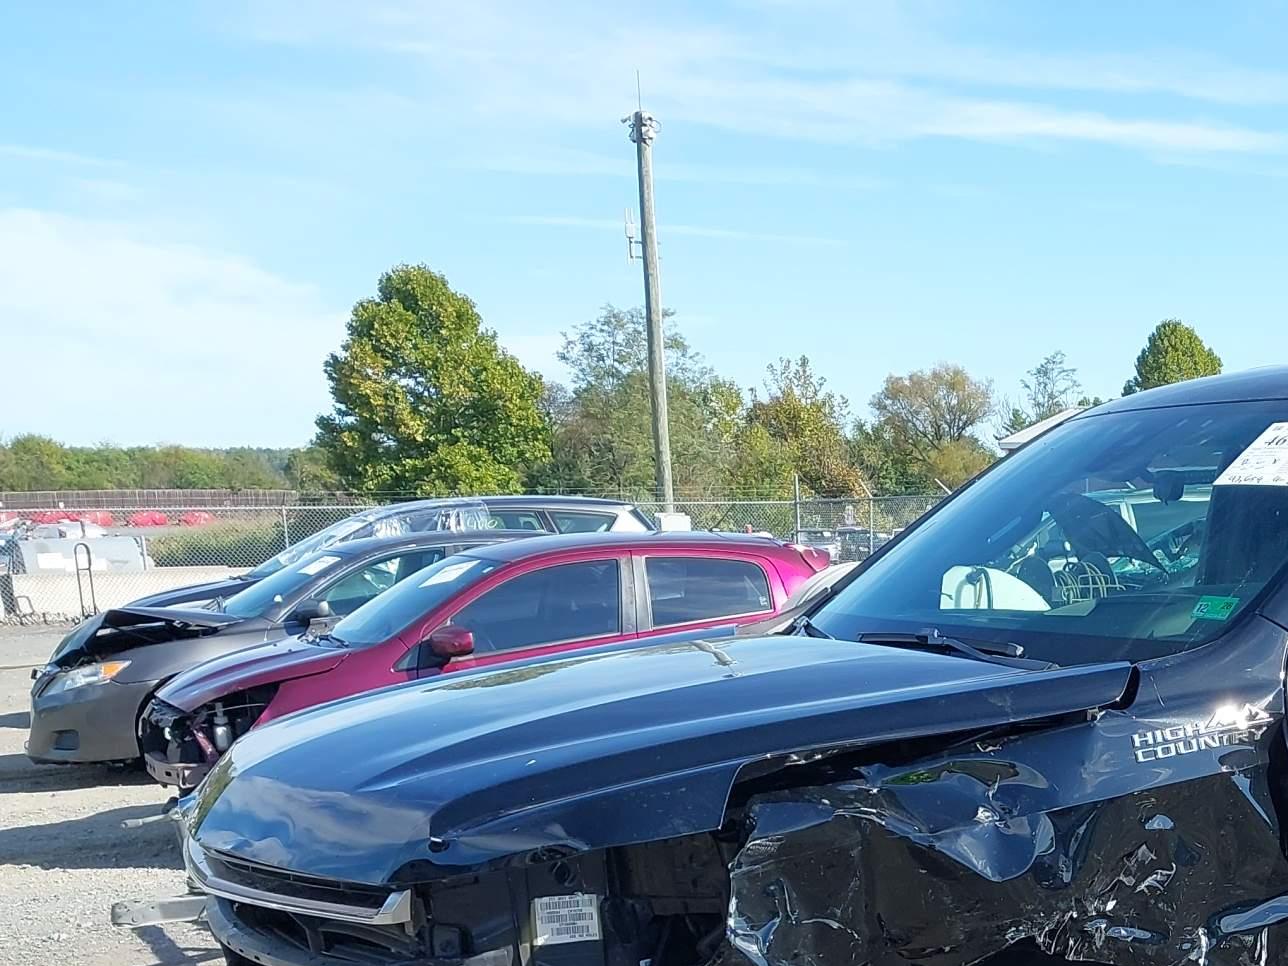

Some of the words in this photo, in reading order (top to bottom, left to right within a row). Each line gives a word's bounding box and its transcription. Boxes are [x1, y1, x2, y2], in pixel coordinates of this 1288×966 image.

[1196, 603, 1209, 613] 12
[1132, 720, 1207, 748] HIGH
[1135, 727, 1268, 763] COUNTRY
